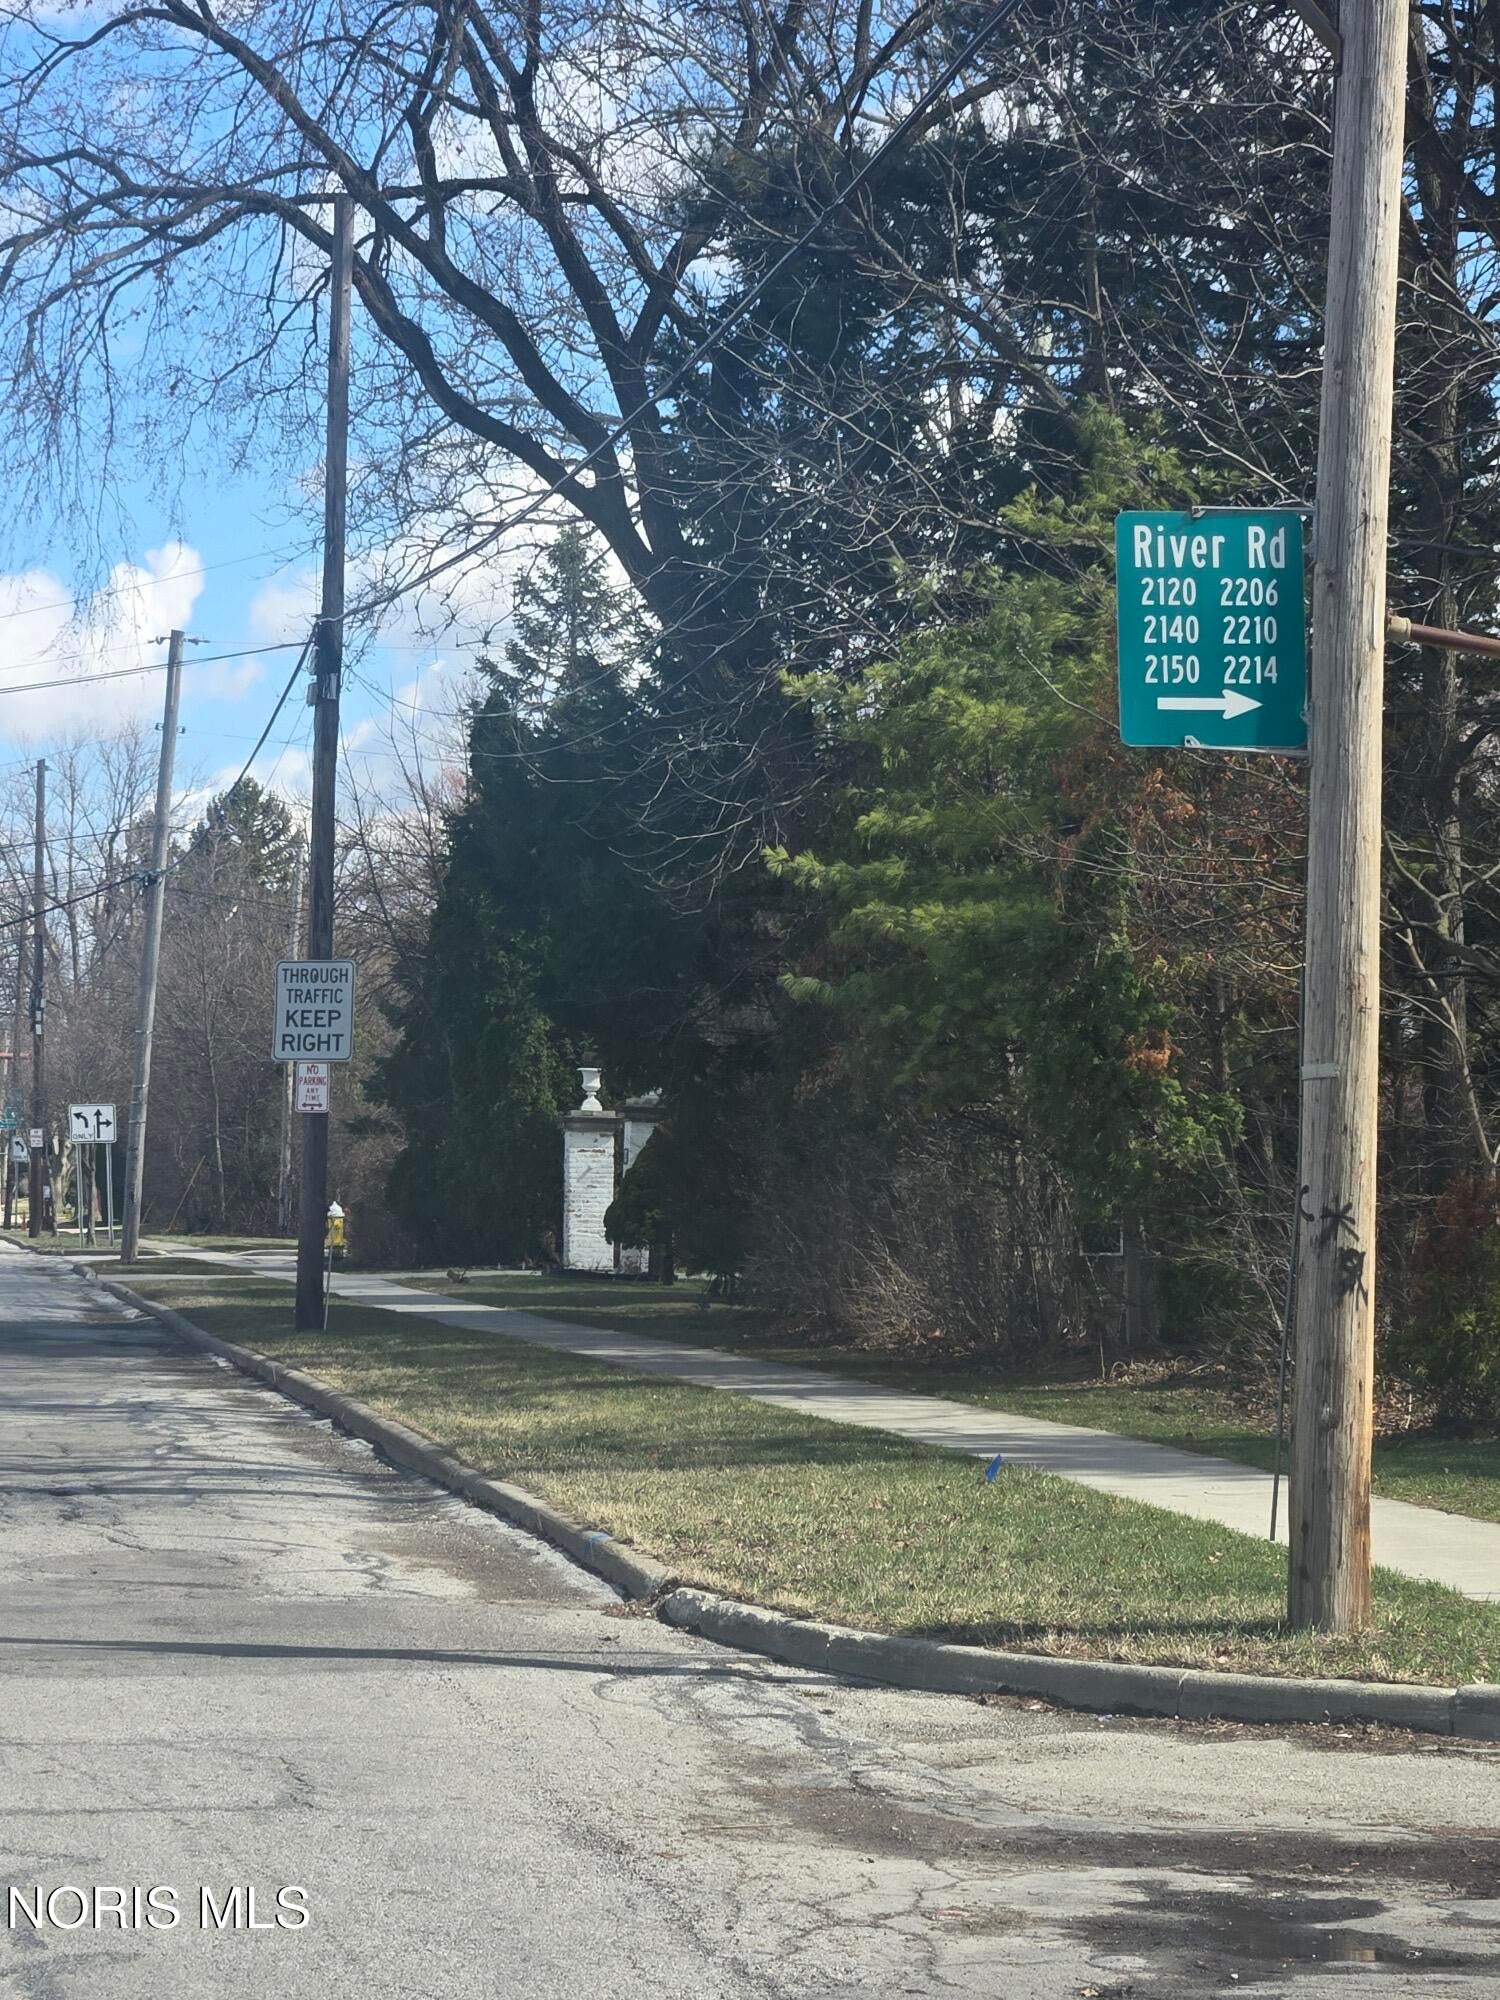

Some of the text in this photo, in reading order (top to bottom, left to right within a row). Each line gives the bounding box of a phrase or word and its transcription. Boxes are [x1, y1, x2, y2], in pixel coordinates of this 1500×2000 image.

[1133, 524, 1286, 568] River Rd
[1141, 577, 1279, 606] 2120 2206
[1143, 615, 1277, 645] 2140 2210
[1144, 655, 1278, 685] 2150 2214
[282, 968, 349, 984] THROUGH
[286, 988, 344, 1004] TRAFFIC
[285, 1009, 342, 1028] KEEP
[281, 1033, 345, 1052] RIGHT
[306, 1065, 320, 1075] NO
[299, 1076, 327, 1086] PARKING
